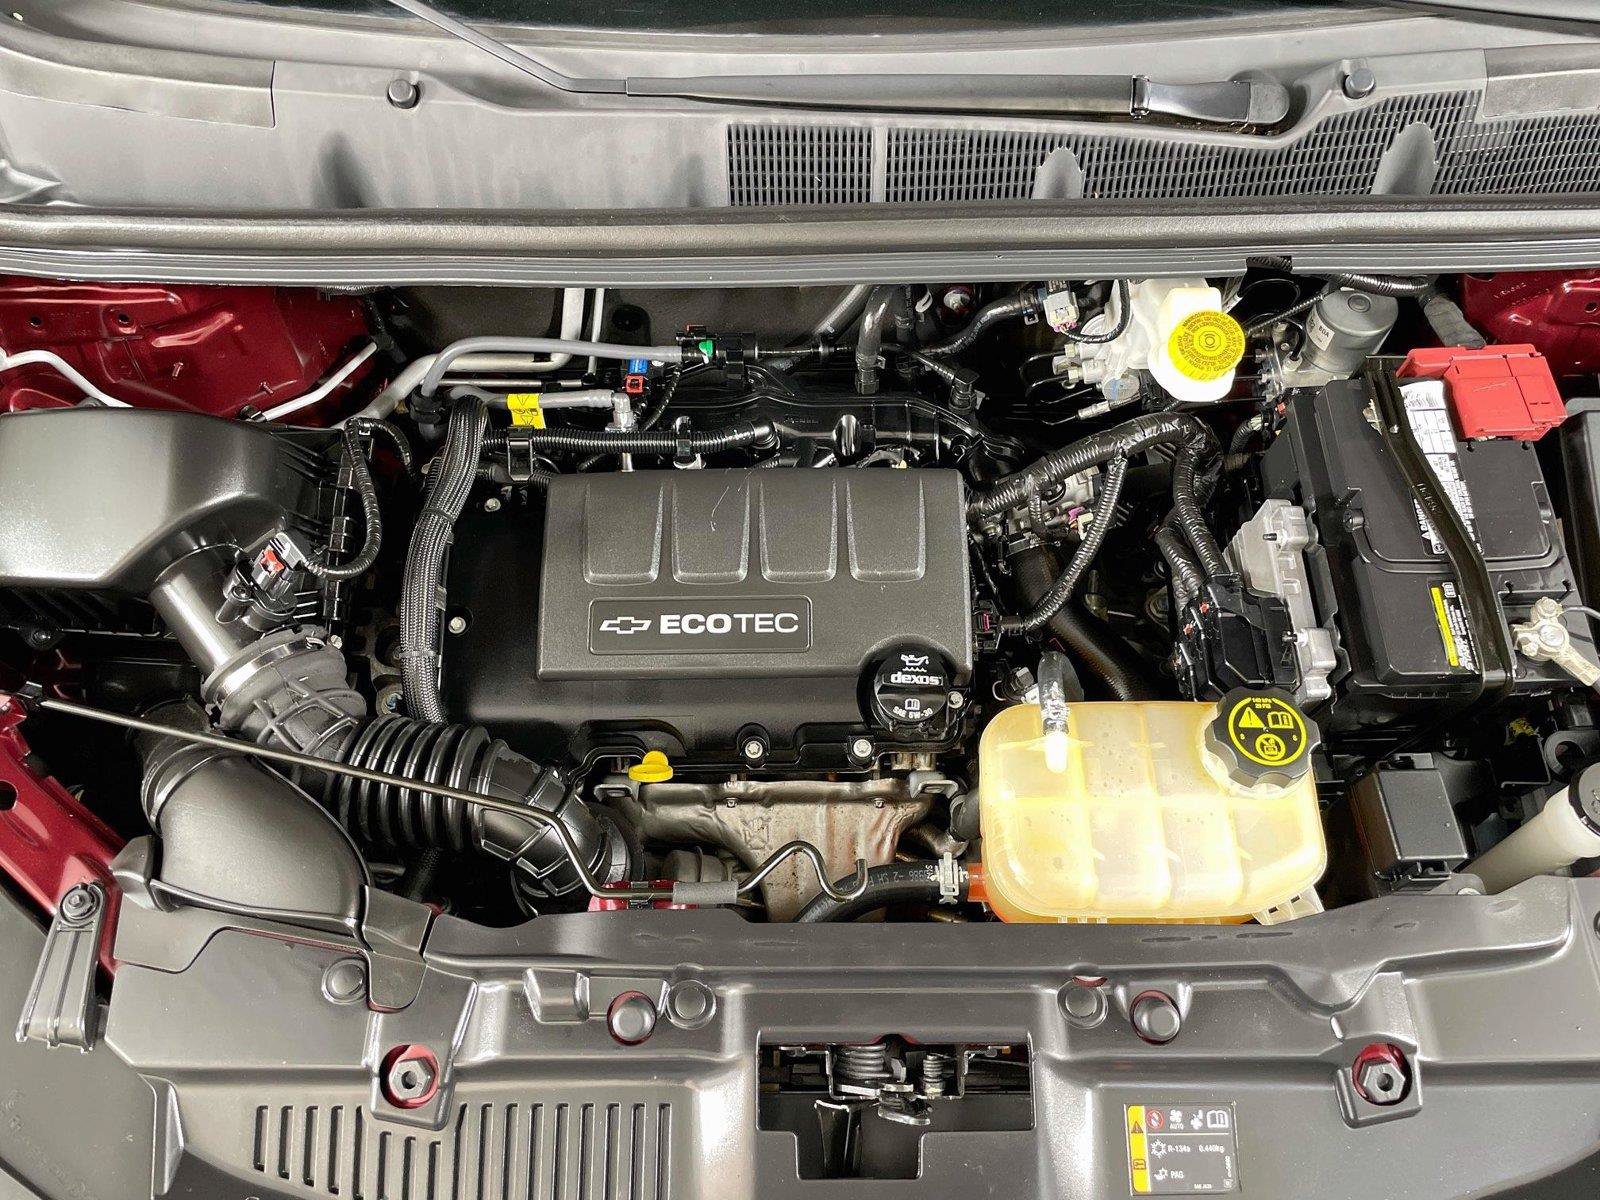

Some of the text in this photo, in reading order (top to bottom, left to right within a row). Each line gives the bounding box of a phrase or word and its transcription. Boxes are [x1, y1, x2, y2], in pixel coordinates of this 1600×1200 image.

[660, 613, 799, 635] ECOTEC
[890, 671, 940, 686] dexos
[892, 705, 934, 719] SAE 5W-30
[1167, 1144, 1191, 1153] R-134a
